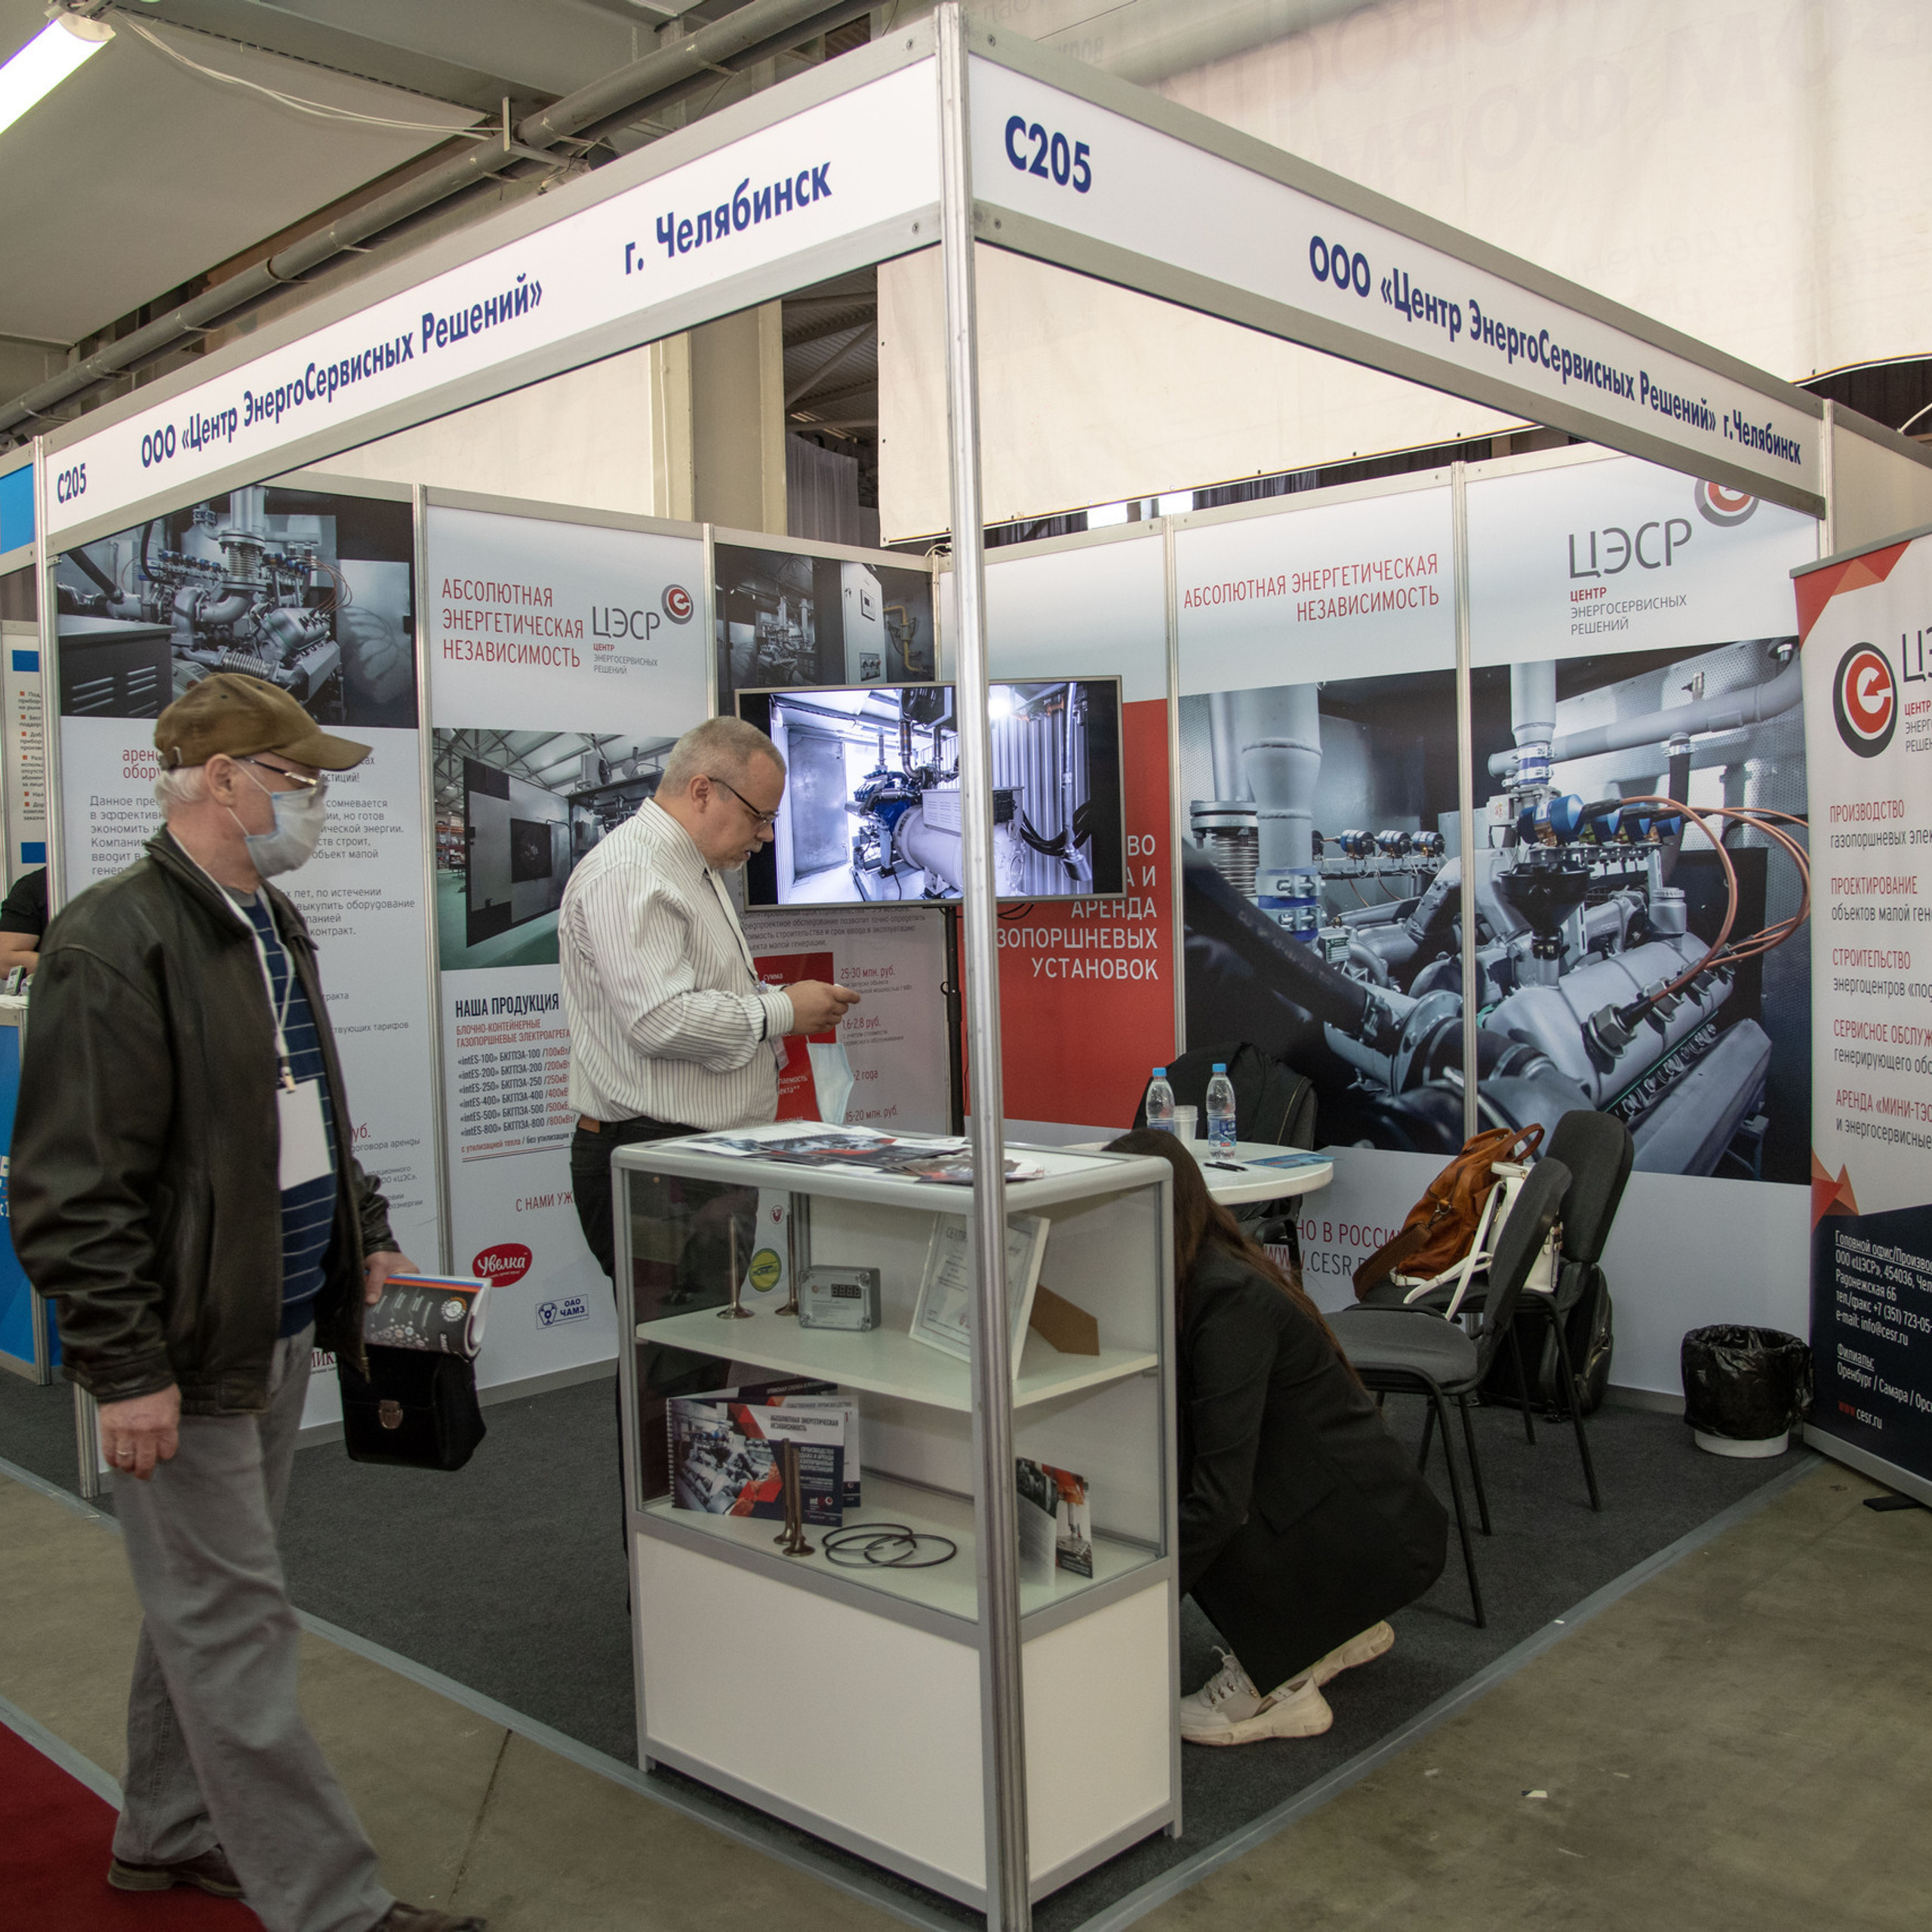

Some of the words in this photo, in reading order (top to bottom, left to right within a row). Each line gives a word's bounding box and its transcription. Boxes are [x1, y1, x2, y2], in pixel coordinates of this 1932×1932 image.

[141, 425, 176, 468] ООО
[181, 407, 237, 451] «Центр
[244, 332, 414, 426] ЭнергоСервисных
[422, 273, 542, 353] Решений»
[625, 242, 644, 275] г.
[657, 162, 832, 258] Челябинск
[1309, 235, 1371, 297] ООО
[1380, 268, 1462, 343] «Центр
[1469, 299, 1635, 401] ЭнергоСервисных
[1640, 371, 1715, 432] Решений»
[1568, 518, 1693, 580] ЦЭСР
[1184, 575, 1286, 609] АБСОЛЮТНАЯ
[1291, 553, 1438, 593] ЭНЕРГЕТИЧЕСКАЯ
[442, 579, 552, 608] АБСОЛЮТНАЯ
[1570, 586, 1607, 604] ЦЕНТР
[1297, 584, 1439, 623] НЕЗАВИСИМОСТЬ
[1571, 594, 1687, 620] ЭНЕРГОСЕРВИСНЫХ
[442, 609, 583, 639] ЭНЕРГЕТИЧЕСКАЯ
[592, 606, 660, 640] ЦЭСР
[1571, 617, 1629, 636] РЕШЕНИЙ
[444, 638, 580, 668] НЕЗАВИСИМОСТЬ
[593, 643, 615, 652] ЦЕНТР
[593, 654, 658, 667] ЭНЕРГОСЕРВИСНЫХ
[594, 665, 627, 675] РЕШЕНИЙ
[1904, 700, 1931, 717] ЦЕНТР
[90, 796, 133, 807] Данное
[326, 800, 388, 808] сомневается
[1829, 799, 1905, 823] ПРОИЗВОДСТВО
[91, 811, 97, 820] в
[91, 825, 149, 834] экономить
[363, 826, 404, 835] энергии.
[336, 838, 371, 848] строит,
[1830, 829, 1906, 851] газопоршневых
[92, 853, 131, 863] вводит
[312, 849, 346, 859] объект
[1143, 866, 1156, 887] И
[1831, 875, 1918, 895] ПРОЕКТИРОВАНИЕ
[331, 888, 381, 897] истечении
[297, 903, 343, 912] выкупить
[346, 900, 415, 911] оборудование
[1071, 897, 1157, 920] АРЕНДА
[1832, 903, 1875, 921] объектов
[1878, 904, 1910, 922] малой
[310, 927, 356, 937] контракт.
[1832, 948, 1911, 970] СТРОИТЕЛЬСТВО
[840, 967, 860, 980] 25-30
[881, 964, 896, 978] руб.
[1032, 958, 1158, 980] УСТАНОВОК
[1834, 977, 1905, 998] энергоцентров
[456, 998, 488, 1017] НАША
[492, 993, 559, 1016] ПРОДУКЦИЯ
[374, 1021, 409, 1031] тарифов
[457, 1019, 541, 1035] БЛОЧНО-КОНТЕЙНЕРНЫЕ
[1834, 1019, 1888, 1042] СЕРВИСНОЕ
[457, 1033, 517, 1048] ГАЗОПОРШНЕВЫЕ
[1835, 1048, 1912, 1072] генерирующего
[862, 1070, 878, 1081] года
[1836, 1089, 1873, 1112] АРЕНДА
[1836, 1118, 1842, 1131] и
[391, 1138, 420, 1149] аренды
[515, 1198, 522, 1212] С
[525, 1194, 555, 1211] НАМИ
[1323, 1221, 1333, 1243] В
[478, 1254, 526, 1276] Увелка
[560, 1305, 586, 1317] ЧАМЗ
[565, 1298, 581, 1306] ОАО
[1860, 1315, 1908, 1346] info@cesr.ru
[1878, 1378, 1909, 1403] Самара
